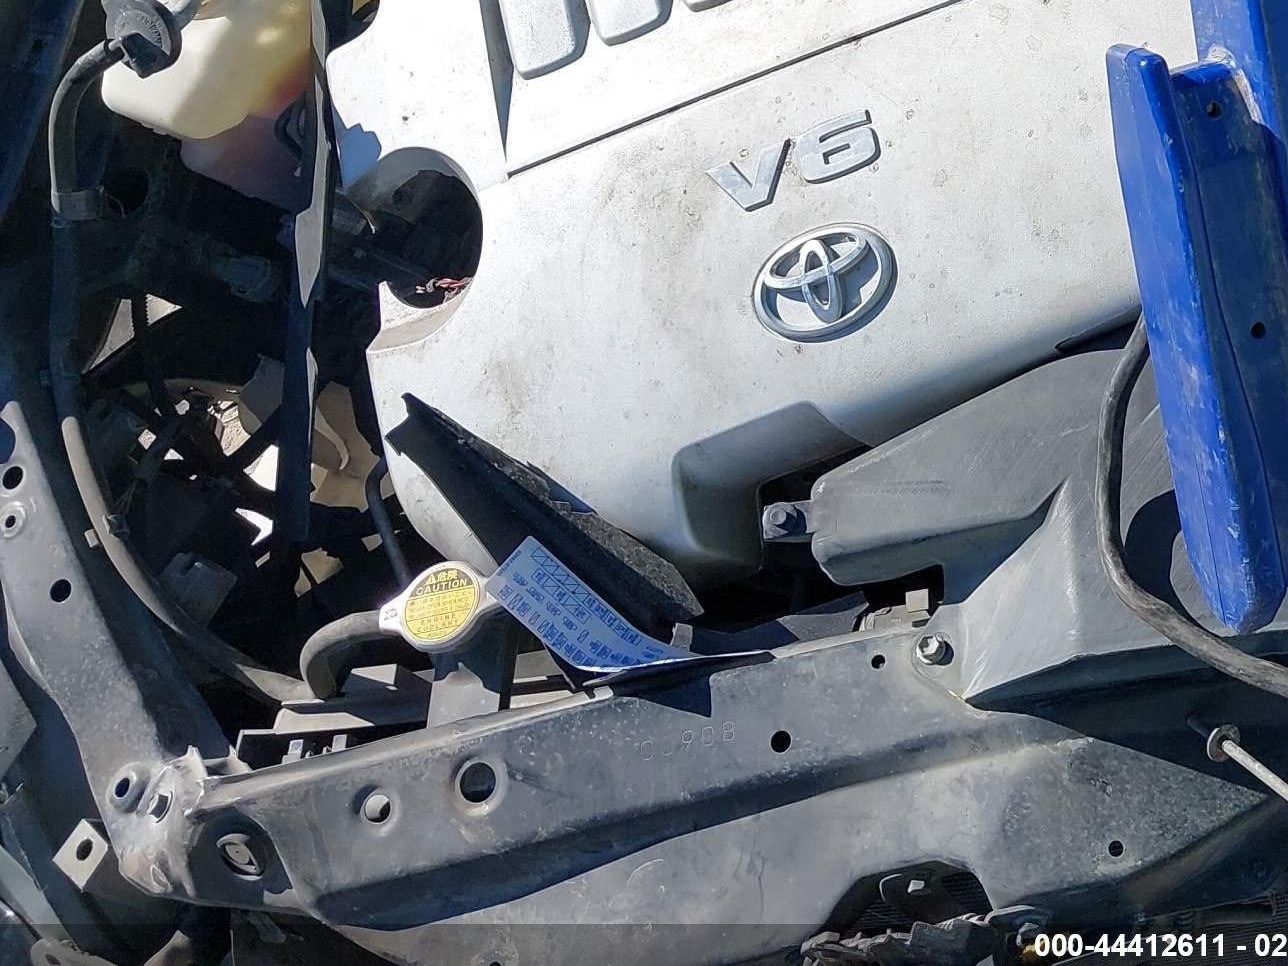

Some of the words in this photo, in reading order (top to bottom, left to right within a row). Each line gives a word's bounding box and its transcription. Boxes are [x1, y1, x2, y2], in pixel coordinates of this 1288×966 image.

[702, 108, 881, 213] V6
[435, 569, 459, 582] 危険
[415, 577, 468, 595] CAUTION
[419, 612, 456, 625] ENGINE
[416, 619, 459, 632] COOLANT
